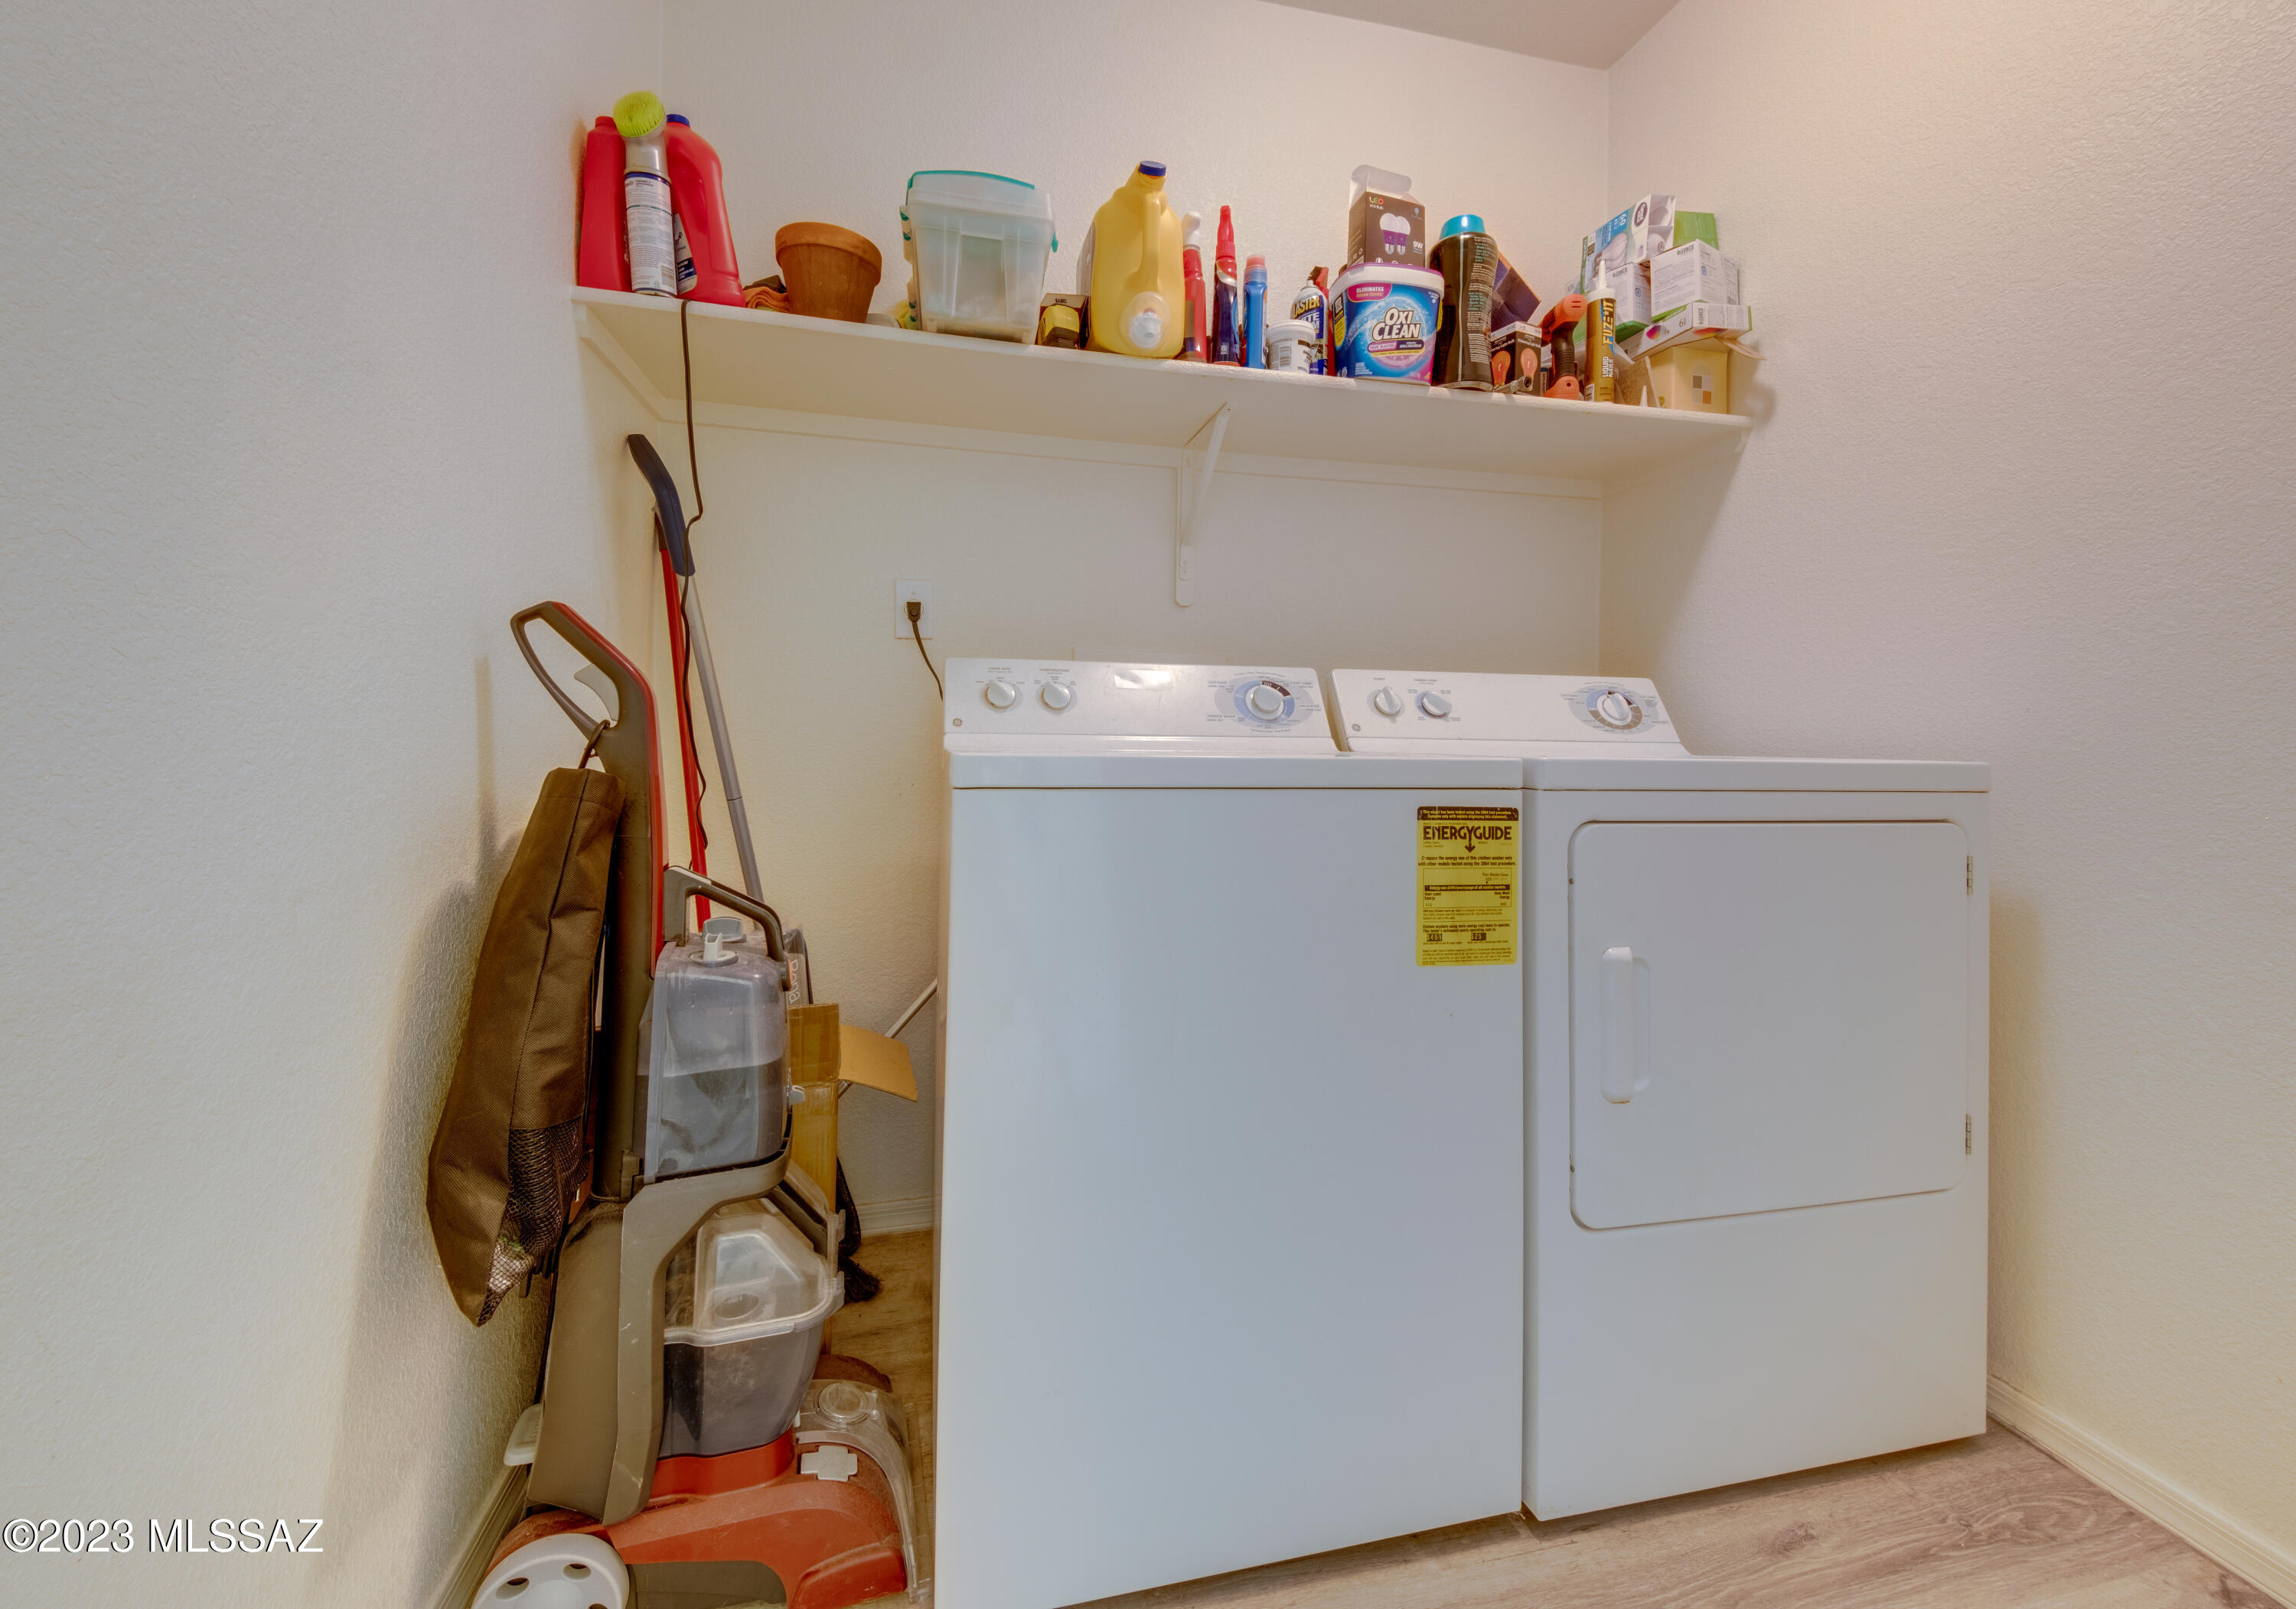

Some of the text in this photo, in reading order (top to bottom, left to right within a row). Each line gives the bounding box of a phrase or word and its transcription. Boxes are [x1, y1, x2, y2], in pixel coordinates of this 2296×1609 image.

[1413, 241, 1423, 249] 9W
[1384, 308, 1414, 326] OXI
[1372, 321, 1421, 341] CLEAN
[1423, 826, 1512, 840] ENERGYGUIDE
